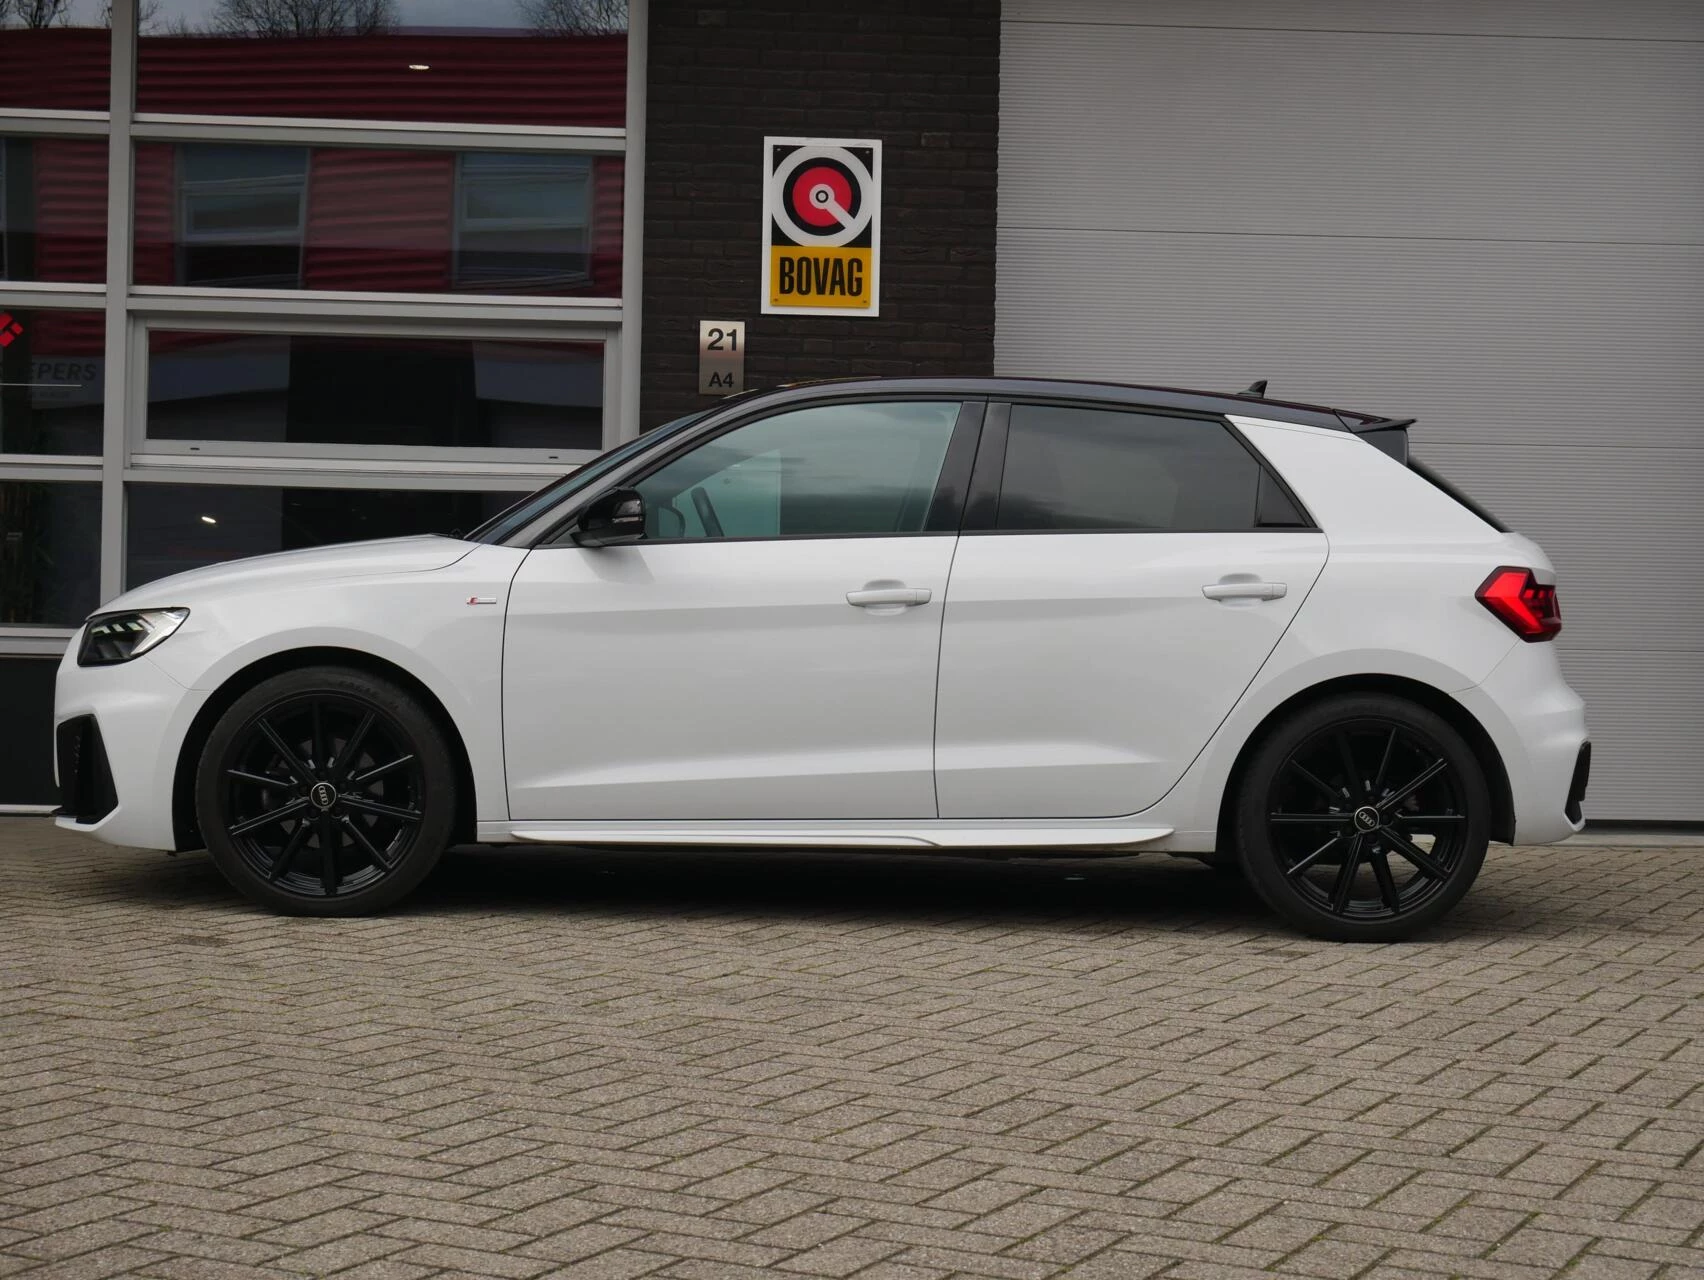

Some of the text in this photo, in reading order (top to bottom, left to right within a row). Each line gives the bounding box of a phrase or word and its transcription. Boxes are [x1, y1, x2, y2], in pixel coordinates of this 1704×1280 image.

[779, 256, 863, 296] BOVAG
[707, 328, 738, 351] 21
[708, 372, 734, 388] A4
